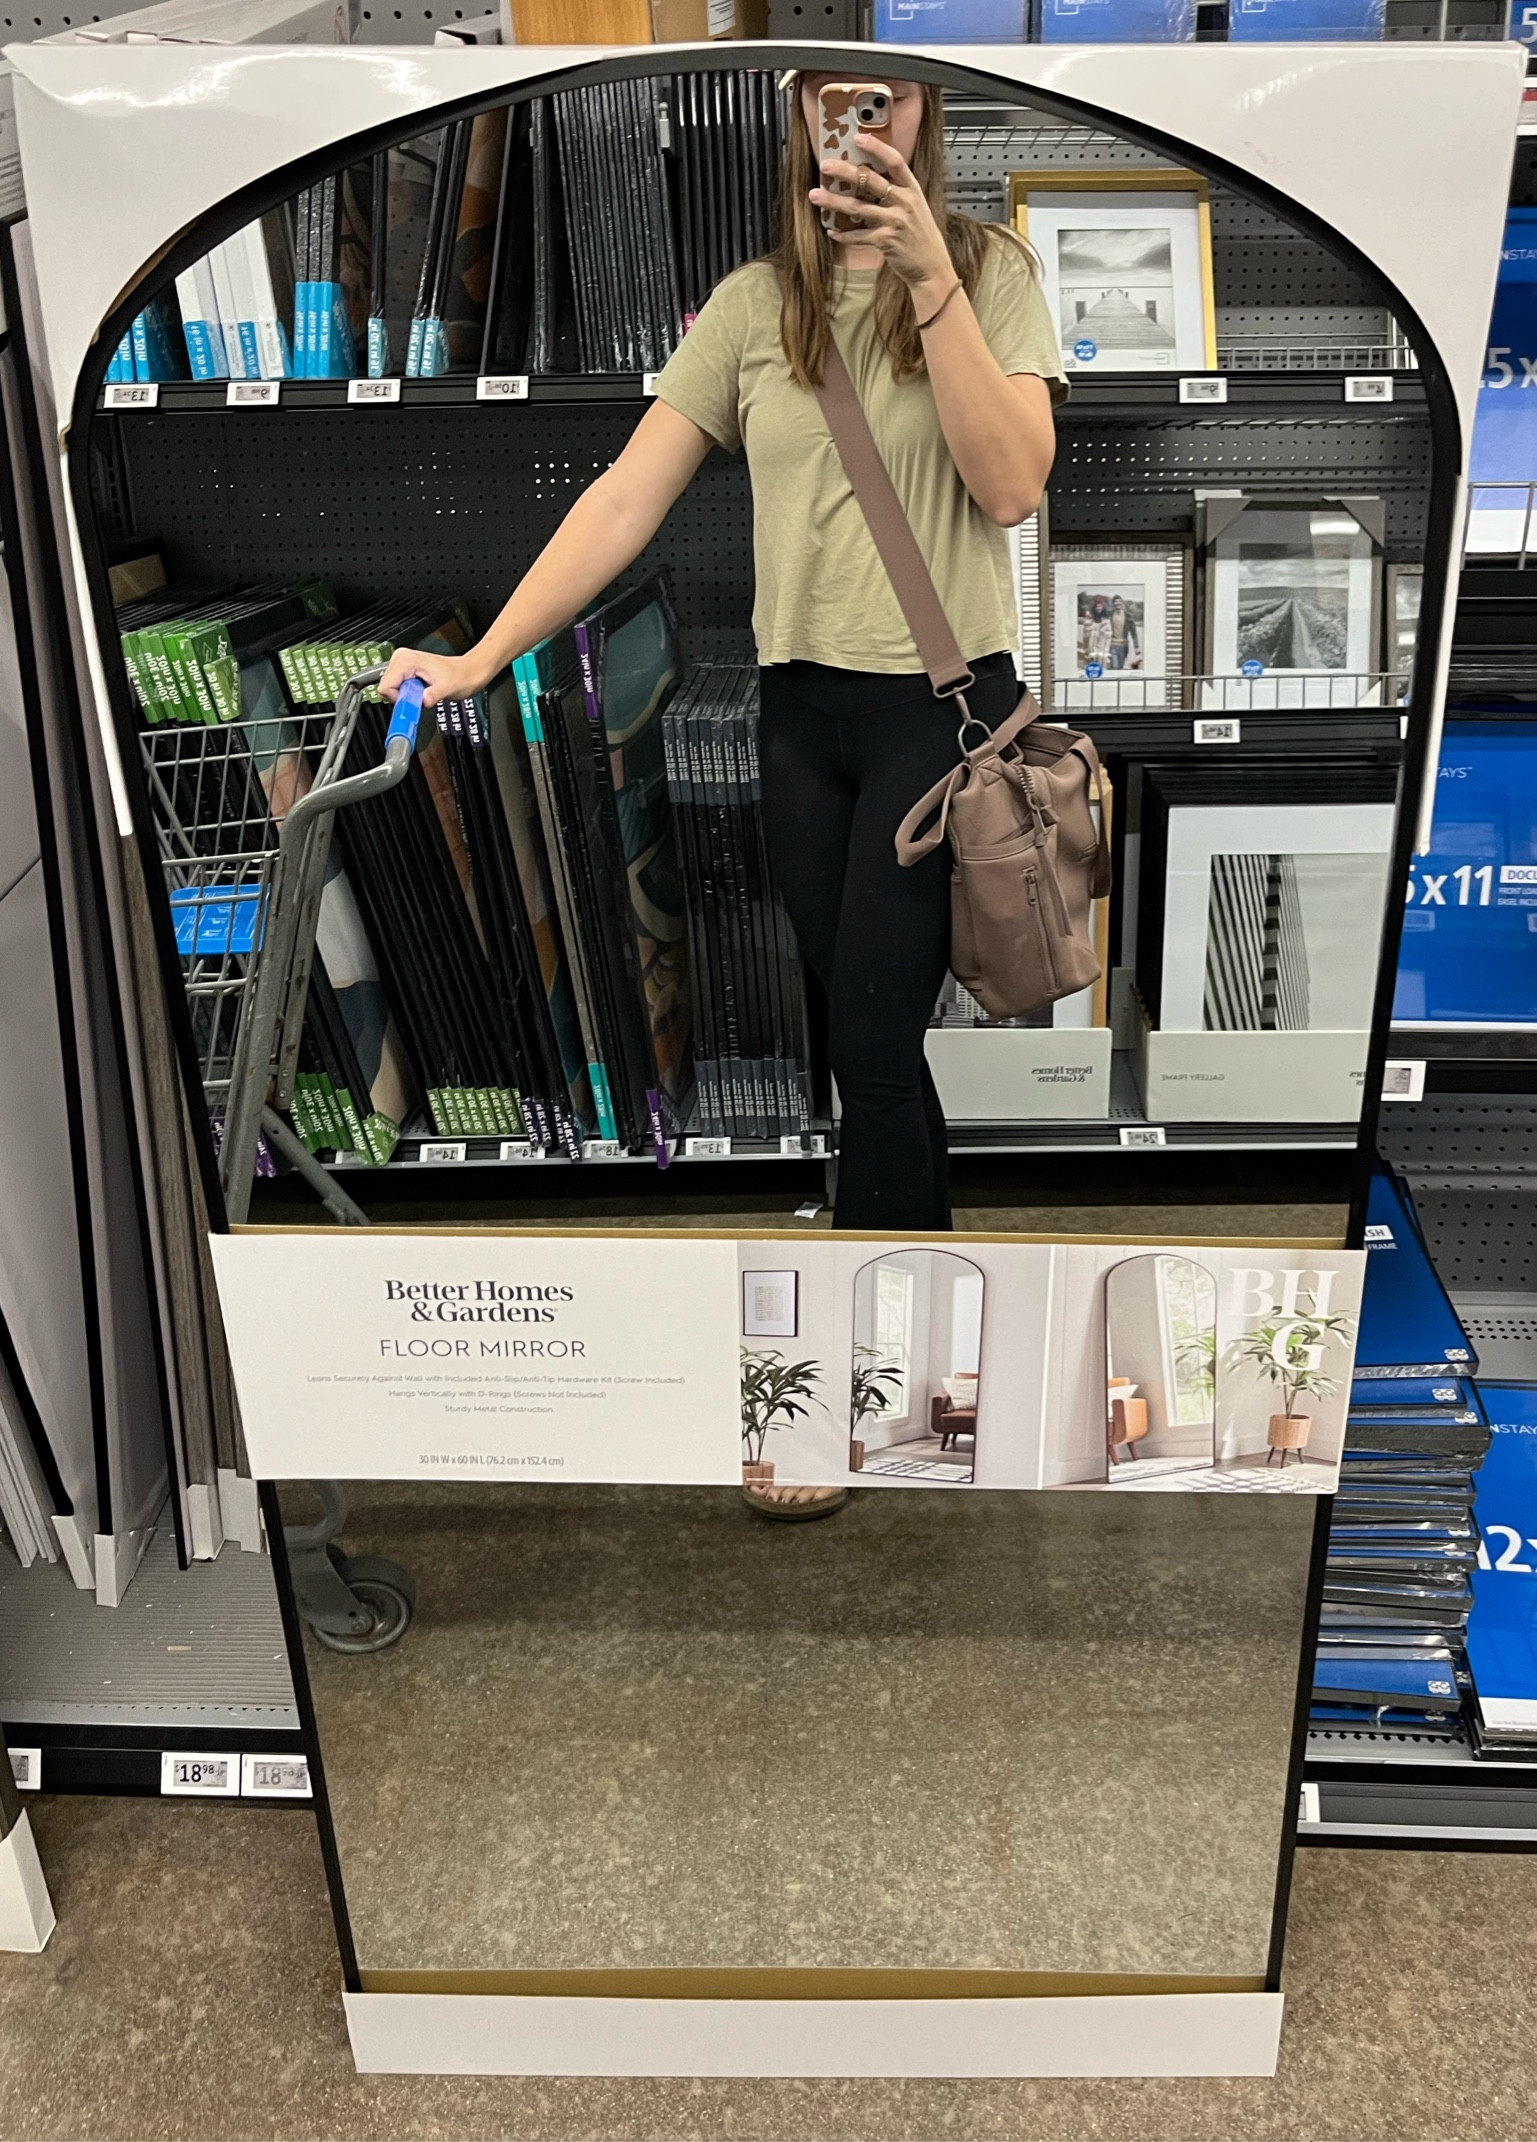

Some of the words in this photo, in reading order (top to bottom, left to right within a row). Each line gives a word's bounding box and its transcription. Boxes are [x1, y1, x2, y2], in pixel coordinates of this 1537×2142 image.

[385, 1280, 469, 1301] Better
[472, 1281, 574, 1302] Homes
[410, 1301, 432, 1322] &
[436, 1302, 556, 1323] Gardens
[380, 1339, 470, 1357] FLOOR
[480, 1340, 586, 1358] MIRROR
[1272, 1321, 1327, 1371] G
[307, 1375, 331, 1383] Leans
[333, 1375, 370, 1384] Securely
[372, 1375, 403, 1384] Against
[404, 1375, 423, 1383] Wall
[425, 1375, 443, 1383] with
[444, 1375, 482, 1383] Included
[557, 1376, 599, 1385] Hardware
[601, 1376, 612, 1384] Kit
[614, 1376, 643, 1385] (Screw
[645, 1377, 686, 1386] Included)
[388, 1390, 416, 1399] Hangs
[417, 1390, 457, 1399] Vertically
[458, 1390, 476, 1398] with
[478, 1390, 512, 1400] D-Rings
[513, 1390, 546, 1399] (Screws
[548, 1391, 564, 1399] Not
[566, 1391, 607, 1400] Included)
[444, 1405, 472, 1414] Sturdy
[473, 1405, 498, 1413] Metal
[499, 1405, 554, 1413] Construction
[418, 1454, 429, 1464] 30
[430, 1455, 440, 1464] IN
[440, 1455, 450, 1464] W
[457, 1455, 469, 1465] 60
[469, 1455, 479, 1465] IN
[486, 1455, 506, 1466] (76.2
[507, 1457, 520, 1465] cm
[527, 1456, 548, 1466] 152.4
[549, 1456, 565, 1467] cm)
